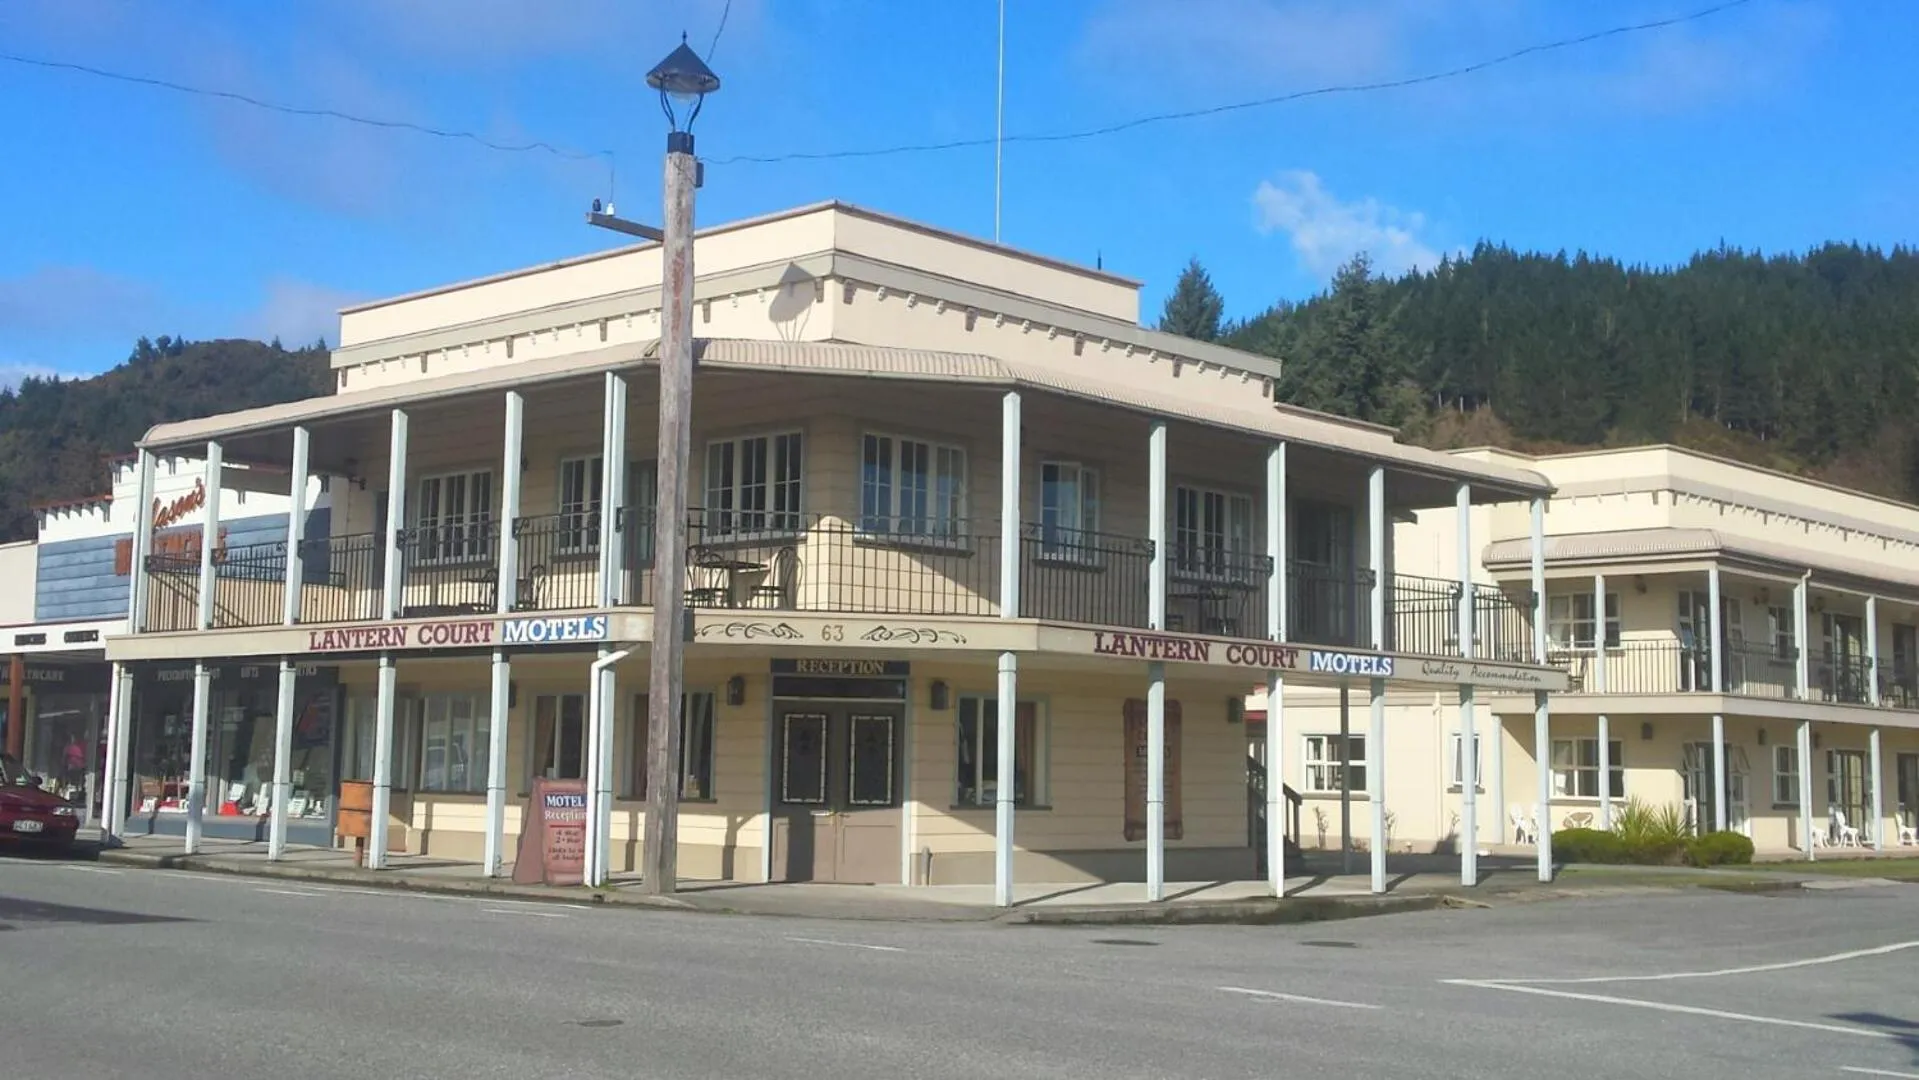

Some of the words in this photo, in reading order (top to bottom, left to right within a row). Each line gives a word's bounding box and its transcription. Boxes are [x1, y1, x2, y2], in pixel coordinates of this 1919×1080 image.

[309, 626, 408, 651] LANTERN
[417, 622, 495, 646] COURT
[503, 616, 606, 642] MOTELS
[821, 624, 844, 642] 63
[1093, 632, 1211, 662] LANTERN
[1226, 644, 1299, 669] COURT
[1311, 651, 1393, 676] MOTELS
[797, 660, 885, 674] RECEPTION
[1421, 660, 1460, 679] Quality
[546, 795, 585, 807] MOTEL
